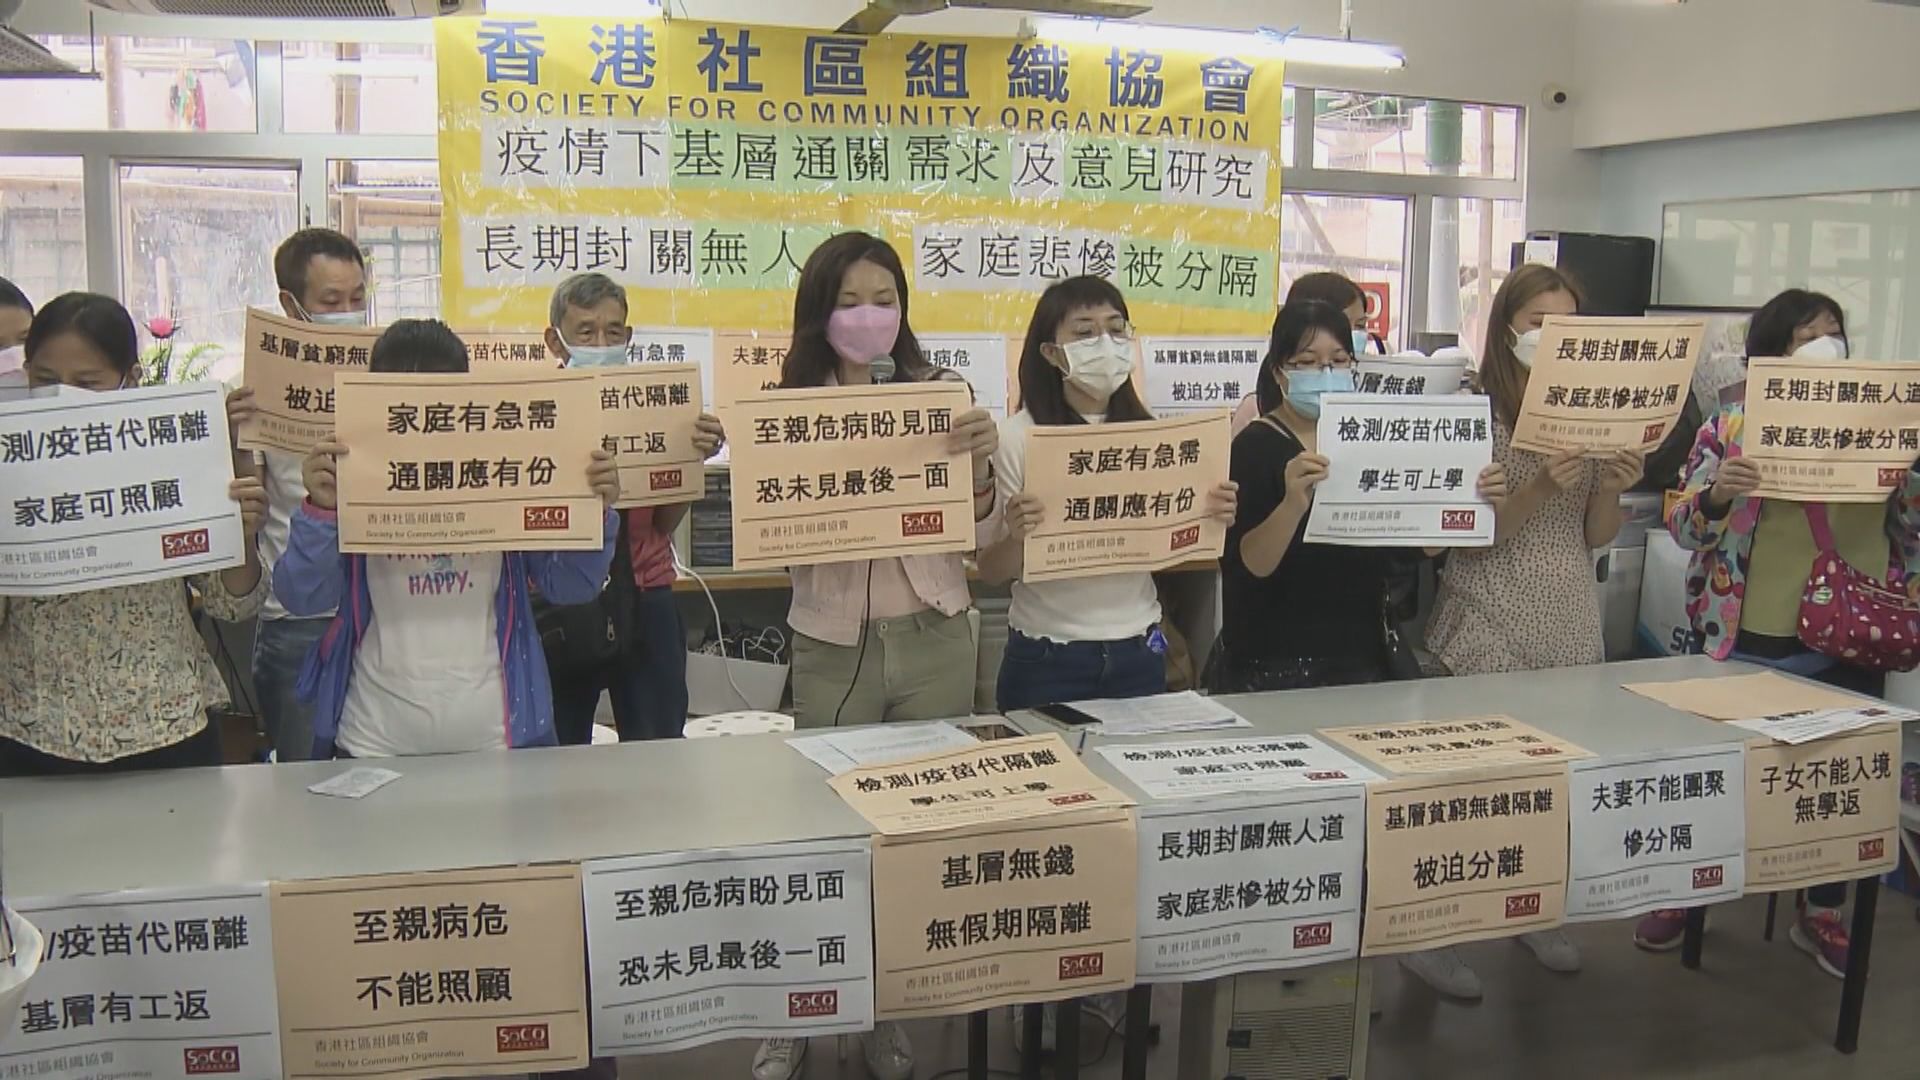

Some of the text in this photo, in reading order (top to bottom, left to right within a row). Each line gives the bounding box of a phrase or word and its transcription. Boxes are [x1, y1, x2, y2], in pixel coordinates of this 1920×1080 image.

[476, 19, 1255, 115] 香港社區組織協會
[479, 89, 1250, 142] SOCIETY FOR COMMUNITY ORGANIZATION
[497, 125, 1254, 200] 疫情下基層通關需求及意見研究
[476, 224, 1259, 298] 長期封關無人 家庭悲慘被分隔
[1556, 337, 1690, 362] 長期封關無人道
[600, 381, 691, 411] 苗代隔離
[1171, 380, 1241, 401] 被迫分離
[1351, 370, 1426, 395] 層無錢
[1543, 383, 1680, 410] 家庭悲慘被分隔
[386, 400, 557, 434] 家庭有急需
[753, 407, 952, 446] 至親危病盼見面
[1337, 416, 1488, 443] 檢測/疫苗代隔離
[1760, 423, 1919, 450] 家庭悲慘被分隔
[386, 455, 557, 492] 通關應有份
[1067, 438, 1200, 476] 家庭有急需
[756, 461, 950, 504] 恐未見最後一面
[1358, 467, 1464, 493] 學生可上學
[14, 478, 183, 527] 家庭可照顧
[1063, 487, 1196, 523] 通關應有份
[1592, 770, 1726, 813] 夫妻不能團聚
[1760, 751, 1891, 795] 子女不能入境
[1384, 788, 1553, 831] 基層貧窮無錢隔離
[1795, 788, 1861, 824] 無學返
[1157, 813, 1345, 861] 長期封關無人道
[1623, 823, 1693, 859] 慘分隔
[941, 844, 1075, 889] 基層無錢
[1413, 844, 1524, 889] 被迫分離
[614, 869, 845, 921] 至親危病盼見面
[1156, 872, 1343, 921] 家庭悲慘被分隔
[40, 915, 249, 964] /疫苗代隔離
[353, 901, 508, 945] 至親病危
[925, 900, 1092, 953] 無假期隔離
[618, 934, 847, 987] 恐未見最後一面
[356, 967, 513, 1011] 不能照顧
[21, 988, 211, 1034] 基層有工返
